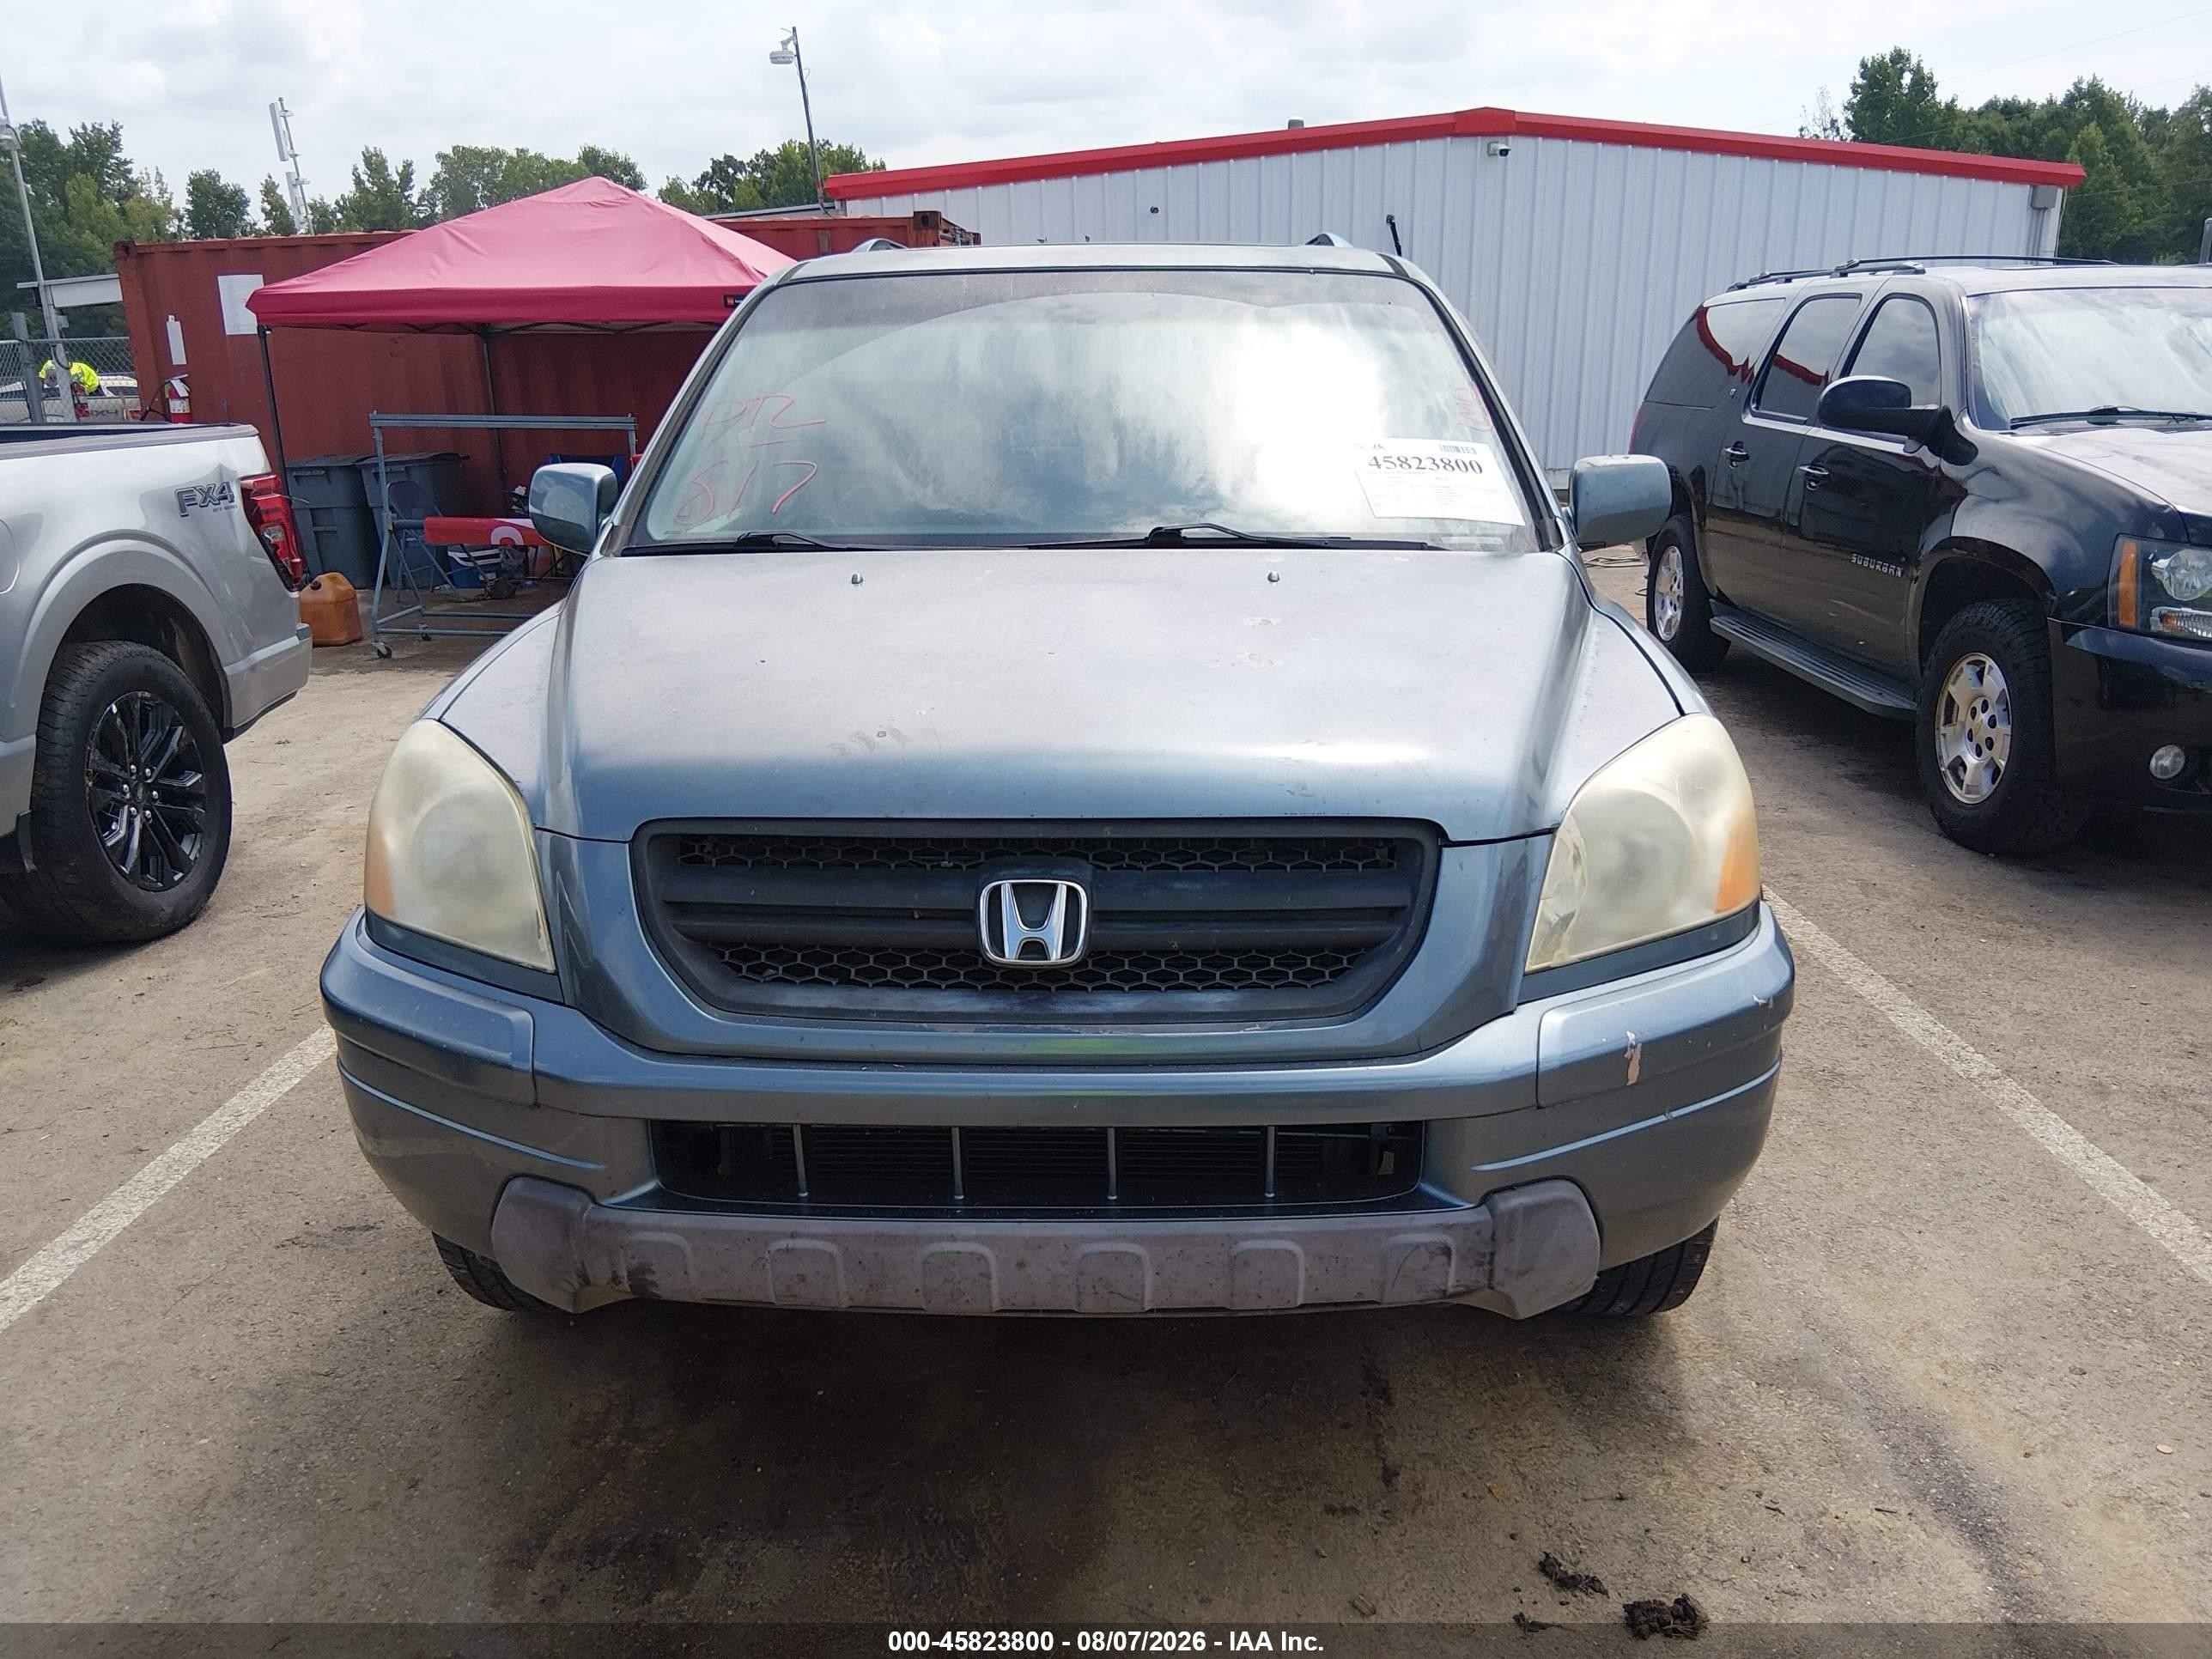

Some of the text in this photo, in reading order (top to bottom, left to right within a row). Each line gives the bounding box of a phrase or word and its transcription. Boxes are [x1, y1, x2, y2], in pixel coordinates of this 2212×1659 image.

[1368, 455, 1484, 475] 45823800
[174, 481, 235, 518] FX4
[1850, 553, 1904, 578] SUBURBAN
